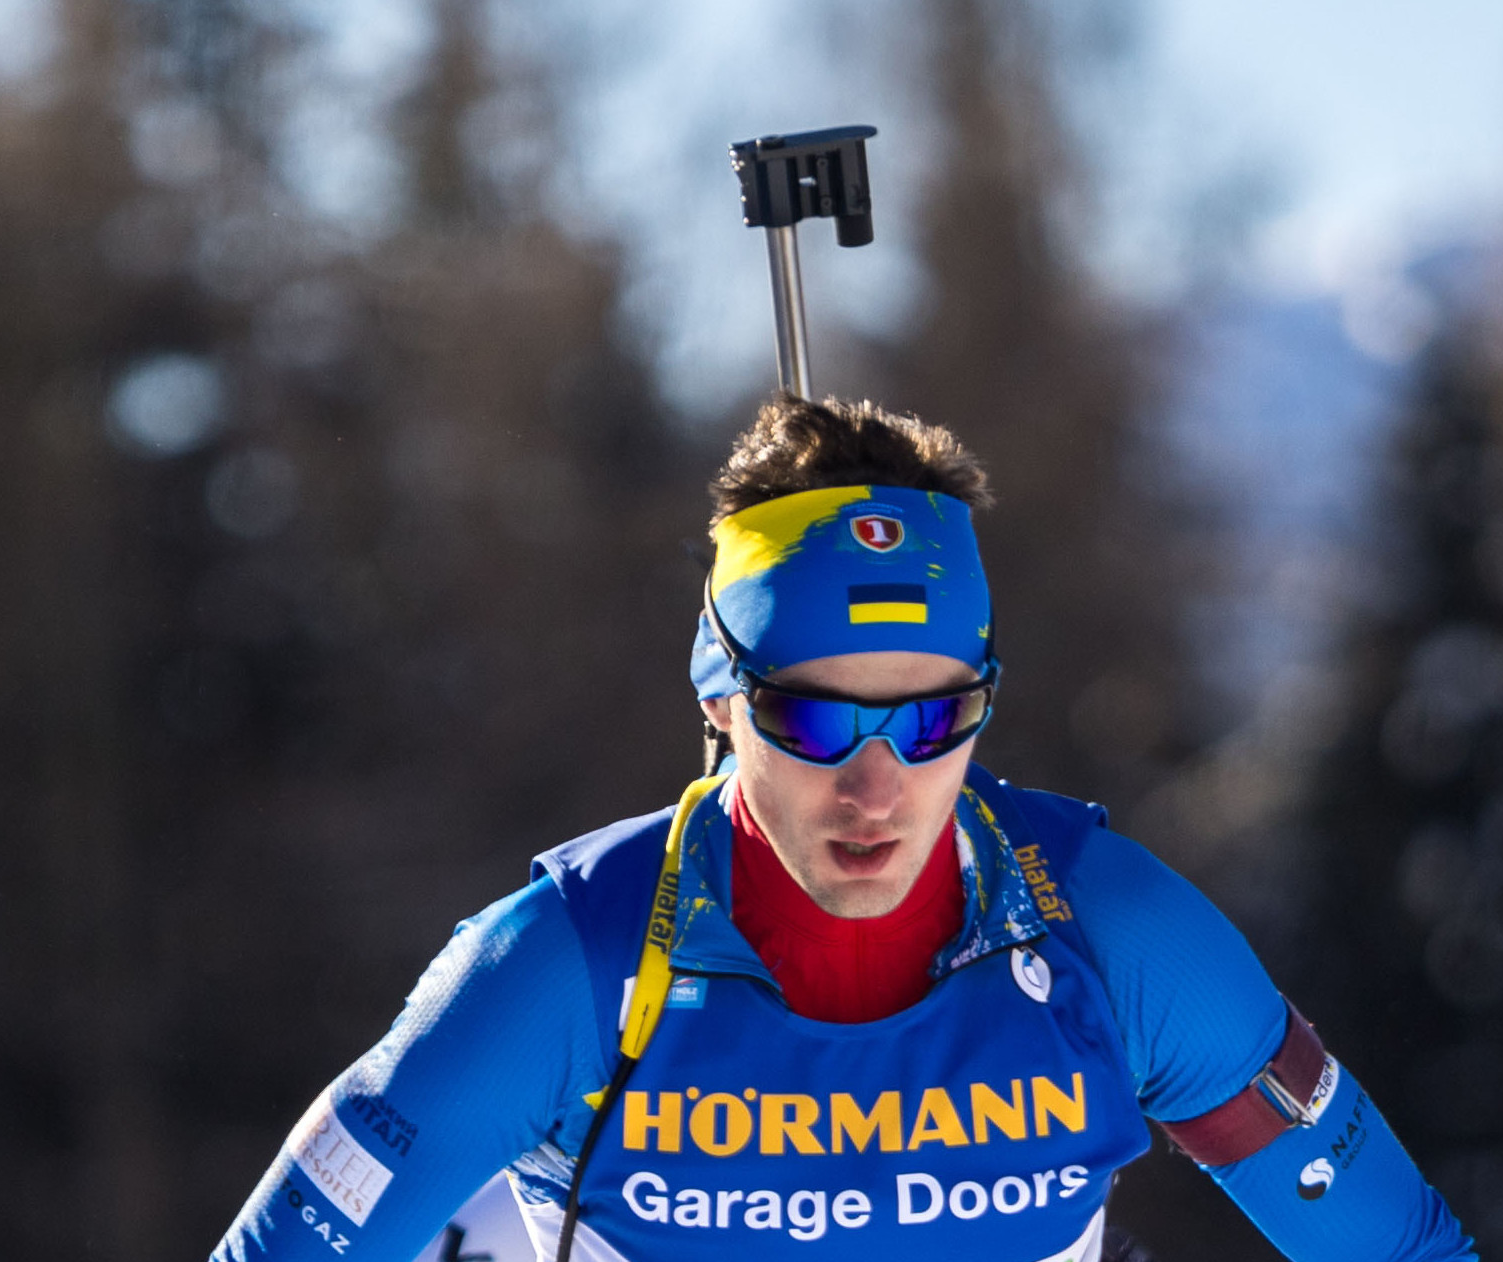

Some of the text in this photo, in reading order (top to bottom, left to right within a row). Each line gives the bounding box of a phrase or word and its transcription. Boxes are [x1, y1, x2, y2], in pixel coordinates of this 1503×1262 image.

[866, 520, 891, 543] 1
[1016, 844, 1065, 922] biatar
[623, 1072, 1086, 1157] HÖRMANN
[622, 1164, 1090, 1241] Garage Doors
